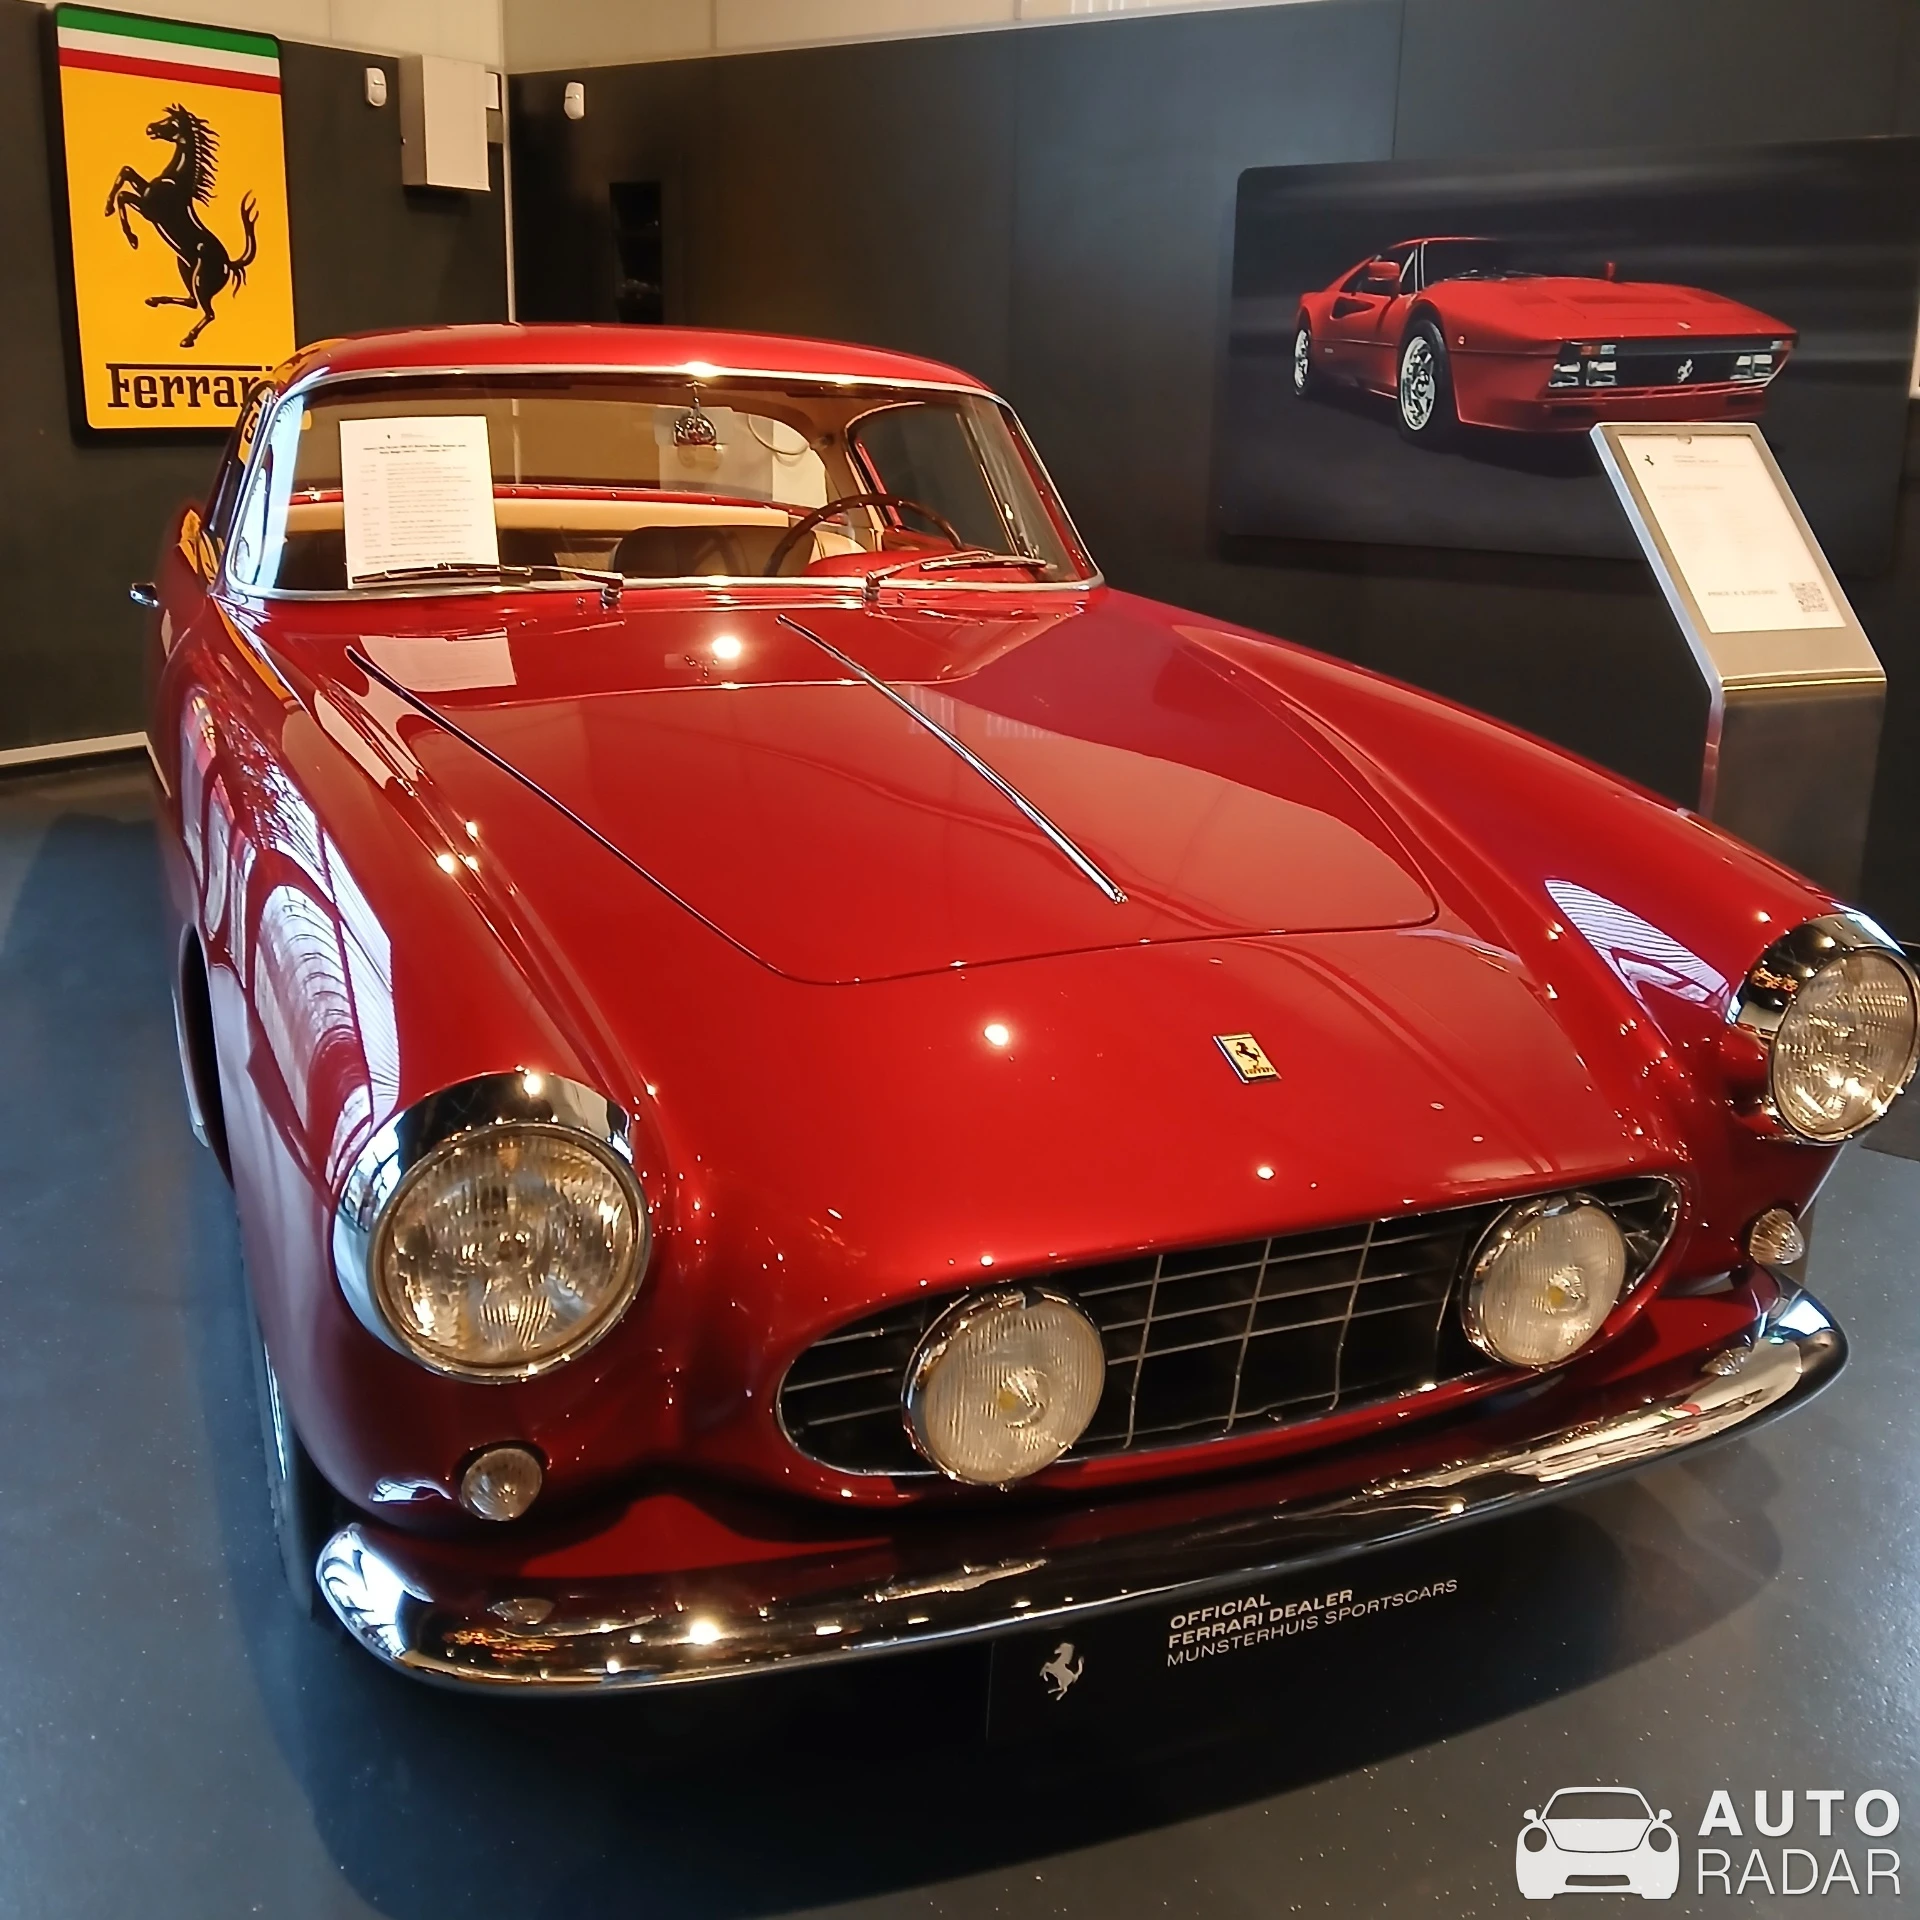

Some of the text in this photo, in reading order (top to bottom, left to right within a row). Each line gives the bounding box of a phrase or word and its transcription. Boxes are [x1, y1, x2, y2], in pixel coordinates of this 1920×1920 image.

[106, 363, 273, 408] Ferrar
[1167, 1579, 1458, 1667] MUNSTERHUIS SPORTSCARS
[1168, 1590, 1353, 1648] FERRARI DEALER
[1170, 1594, 1271, 1629] OFFICIAL
